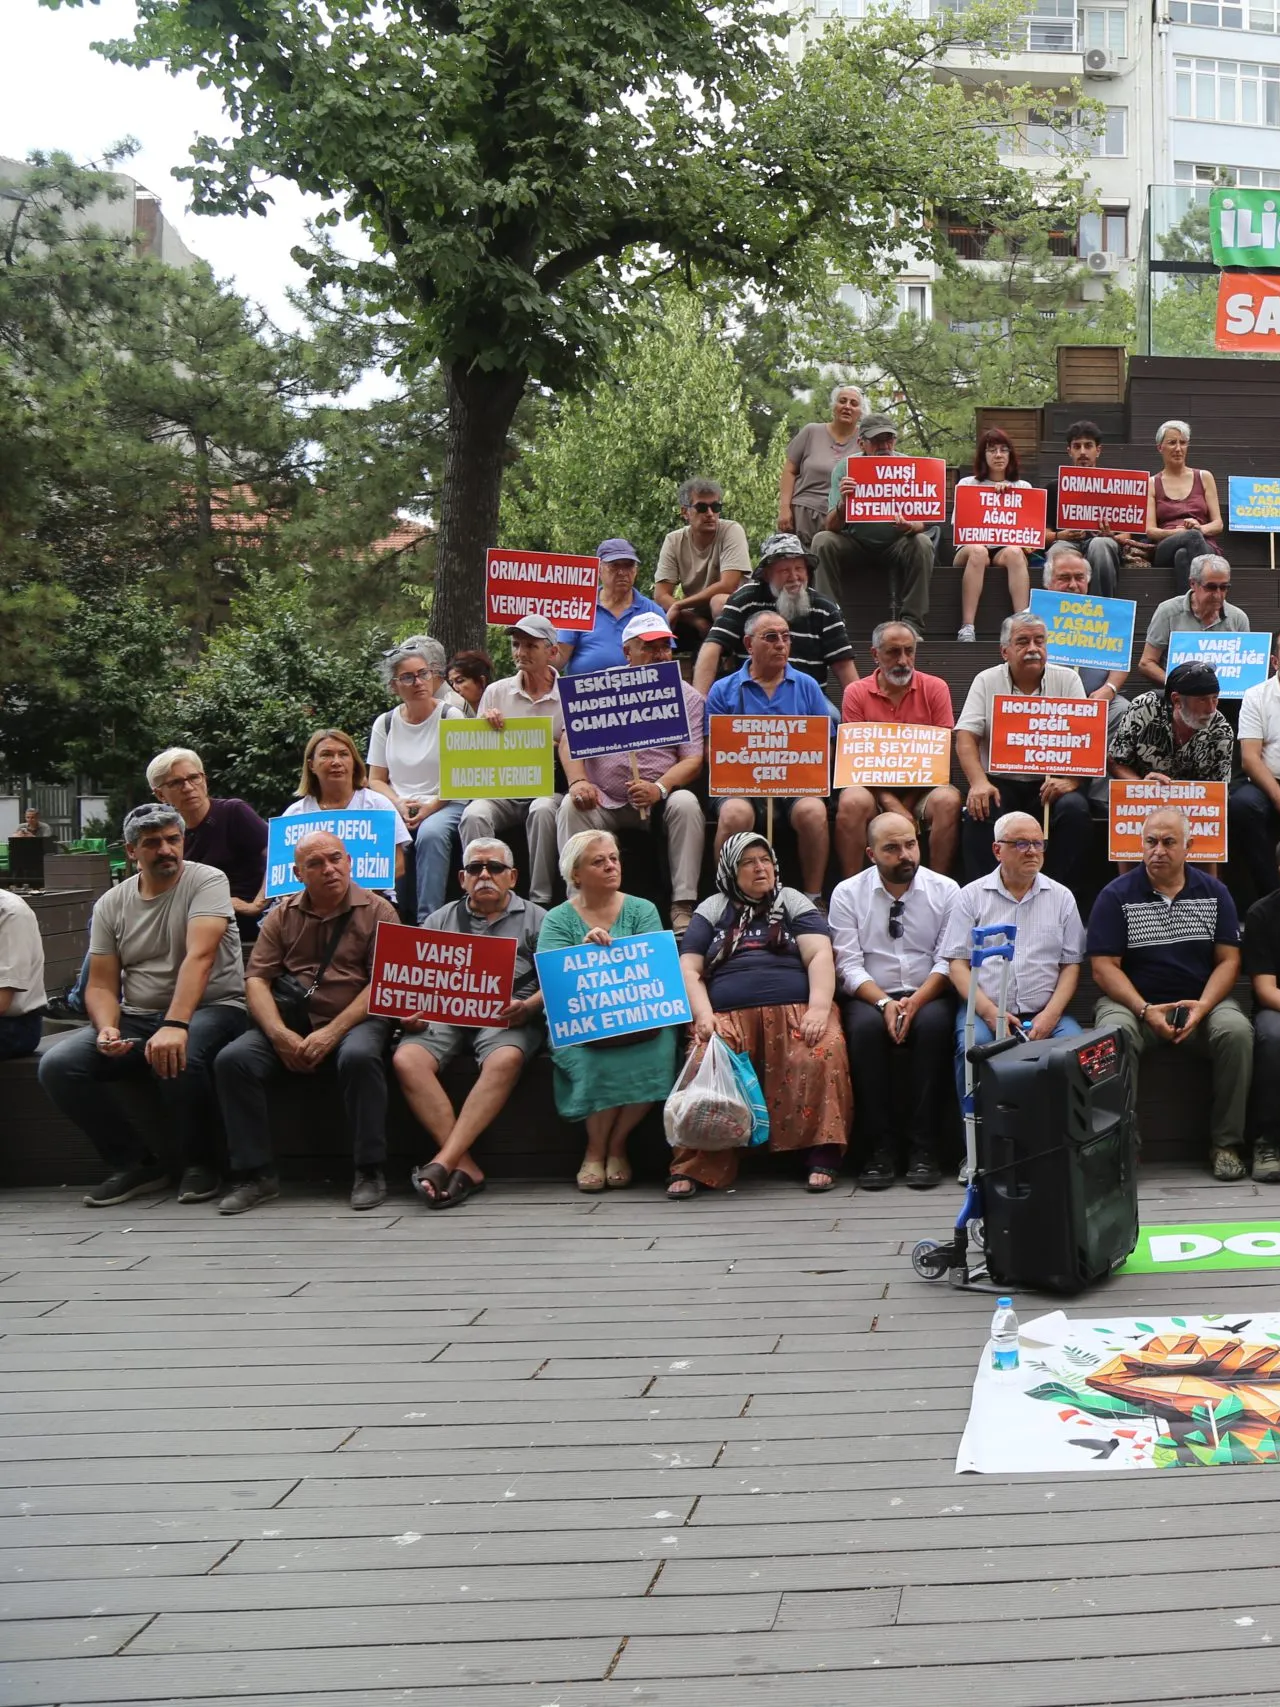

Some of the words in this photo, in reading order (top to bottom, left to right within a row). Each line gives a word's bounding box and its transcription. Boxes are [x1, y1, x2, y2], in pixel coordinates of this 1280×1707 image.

[875, 464, 916, 482] VAHŞİ
[855, 482, 937, 498] MADENCİLİK
[1061, 475, 1147, 497] ORMANLARIMIZI
[850, 499, 941, 517] İSTEMİYORUZ
[979, 491, 1002, 507] TEK
[1003, 490, 1023, 508] BİR
[983, 508, 1017, 525] AĞACI
[1062, 502, 1144, 525] VERMEYECEĞİZ
[958, 528, 1041, 545] VERMEYECEĞİZ
[489, 560, 596, 587] ORMANLARIMIZI
[491, 595, 591, 621] VERMEYECEĞİZ
[1060, 600, 1104, 617] DOĞA
[1046, 631, 1123, 652] ZGÜRLÜK!
[1198, 637, 1242, 652] VAHŞİ
[574, 666, 659, 693] ESKİŞEHİR
[568, 696, 617, 713] MADEN
[619, 687, 676, 706] HAVZASI
[1002, 700, 1098, 717] HOLDİNGLERİ
[571, 703, 679, 732] OLMAYACAK!
[732, 719, 807, 733] SERMAYE
[1029, 715, 1070, 731] DEĞİL
[503, 729, 546, 749] SUYUMU
[748, 733, 788, 748] ELİNİ
[842, 726, 947, 743] YEŞİLLİĞİMİZ
[1007, 731, 1091, 750] ESKİŞEHİR'İ
[715, 747, 823, 764] DOĞAMIZDAN
[843, 741, 875, 754] HER
[879, 740, 945, 757] ŞEYİMİZ
[1025, 750, 1072, 764] KORU!
[451, 767, 496, 787] MADENE
[499, 766, 542, 785] VERMEM
[752, 766, 787, 783] ÇEK!
[850, 768, 933, 784] VERMEYİZ
[1126, 782, 1206, 802] ESKİŞEHİR
[337, 819, 378, 845] DEFOL,
[271, 865, 287, 886] BU
[357, 854, 389, 879] BİZİM
[416, 942, 473, 964] VAHŞİ
[563, 943, 655, 972] ALPAGUT-
[383, 962, 501, 994] MADENCİLİK
[576, 964, 650, 992] ATALAN
[375, 983, 504, 1020] İSTEMİYORUZ
[568, 980, 665, 1013] SİYANÜRÜ
[555, 1017, 596, 1039] HAK
[601, 999, 686, 1029] ETMİYOR
